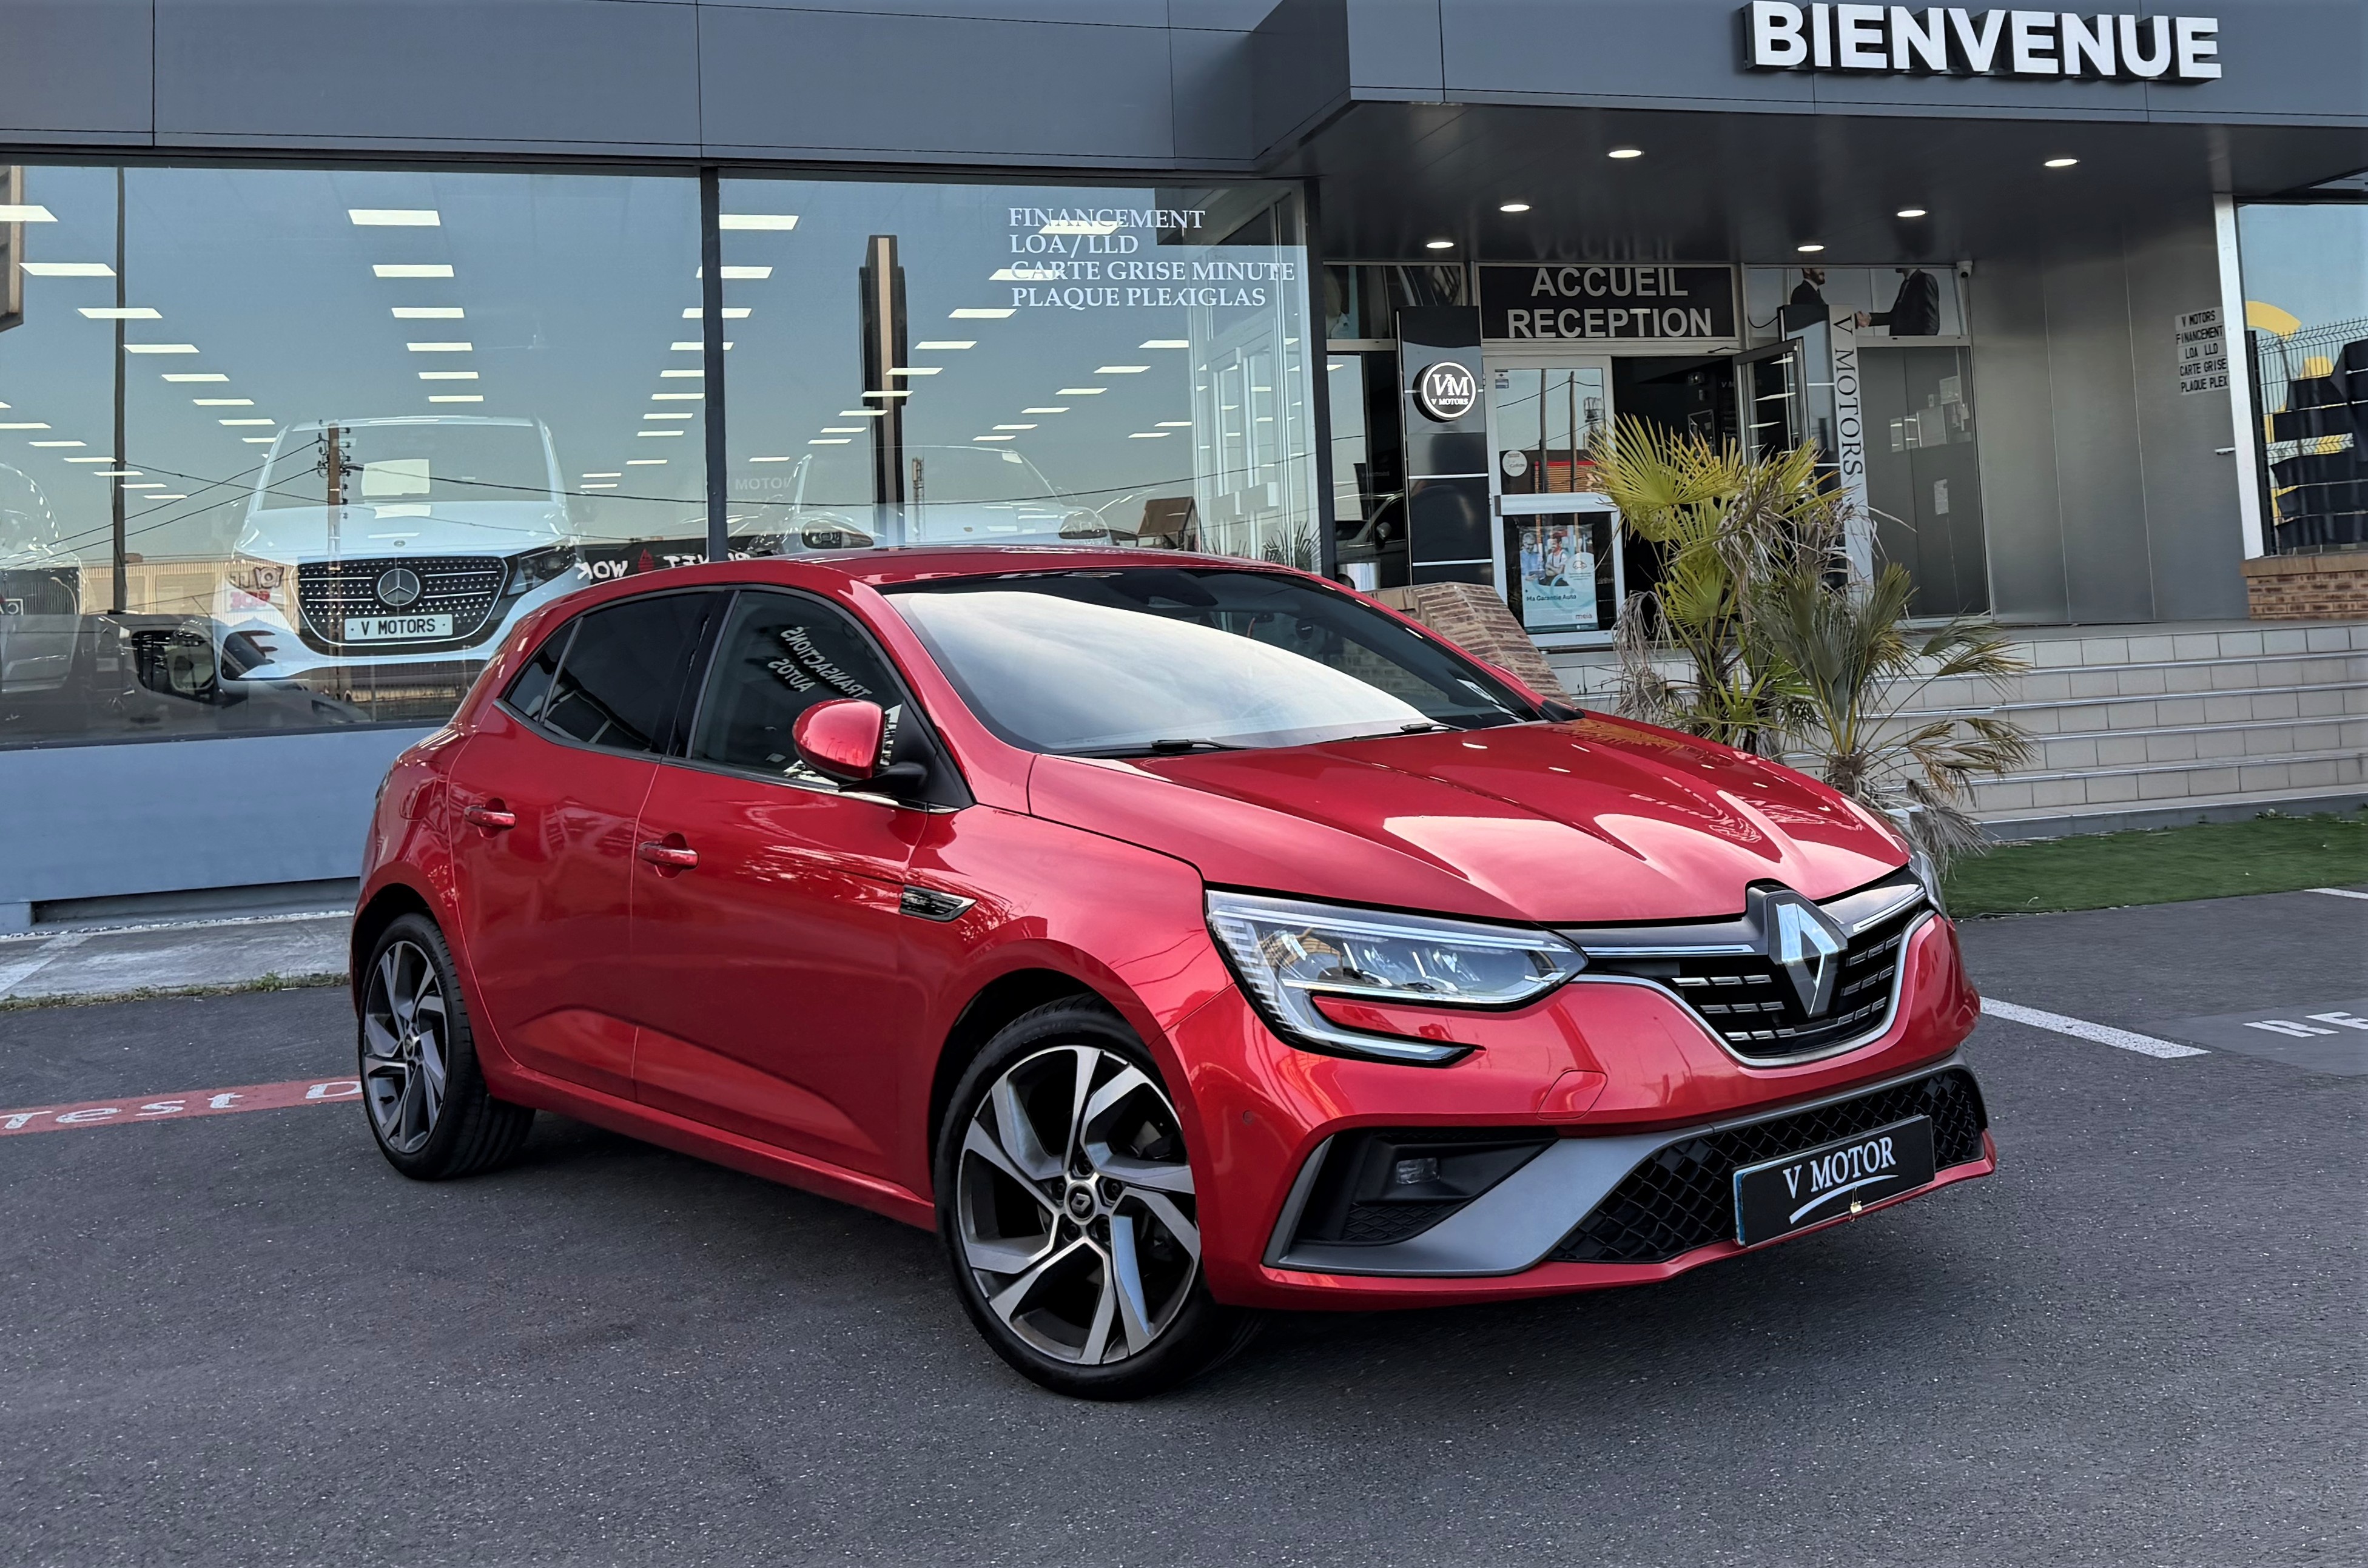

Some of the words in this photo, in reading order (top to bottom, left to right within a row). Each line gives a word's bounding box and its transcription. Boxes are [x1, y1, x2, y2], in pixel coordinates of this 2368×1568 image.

[1752, 1, 2222, 79] BIENVENUE
[1008, 207, 1206, 229] FINANCEMENT
[1011, 261, 1100, 280] CARTE
[1108, 261, 1185, 280] GRISE
[1191, 262, 1295, 281] MINUTE
[1530, 267, 1689, 297] ACCUEIL
[1012, 288, 1120, 311] PLAQUE
[1127, 288, 1266, 306] PLEXIGLAS
[1507, 308, 1712, 338] RECEPTION
[1833, 317, 1854, 335] V
[2182, 316, 2186, 327] V
[2189, 310, 2216, 326] MOTORS
[2176, 325, 2223, 345] FINANCEMENT
[2185, 346, 2199, 359] LOA
[2204, 343, 2218, 355] LLD
[2180, 363, 2202, 376] CARTE
[2204, 358, 2227, 372] GRISE
[1432, 374, 1470, 396] VM
[2181, 379, 2207, 392] PLAQUE
[2210, 375, 2228, 388] PLEX
[1835, 348, 1863, 476] MOTORS
[361, 621, 369, 636] V
[378, 618, 436, 635] MOTORS
[0, 1092, 244, 1130] Test
[1782, 1164, 1802, 1199] V
[1809, 1136, 1896, 1193] MOTOR
